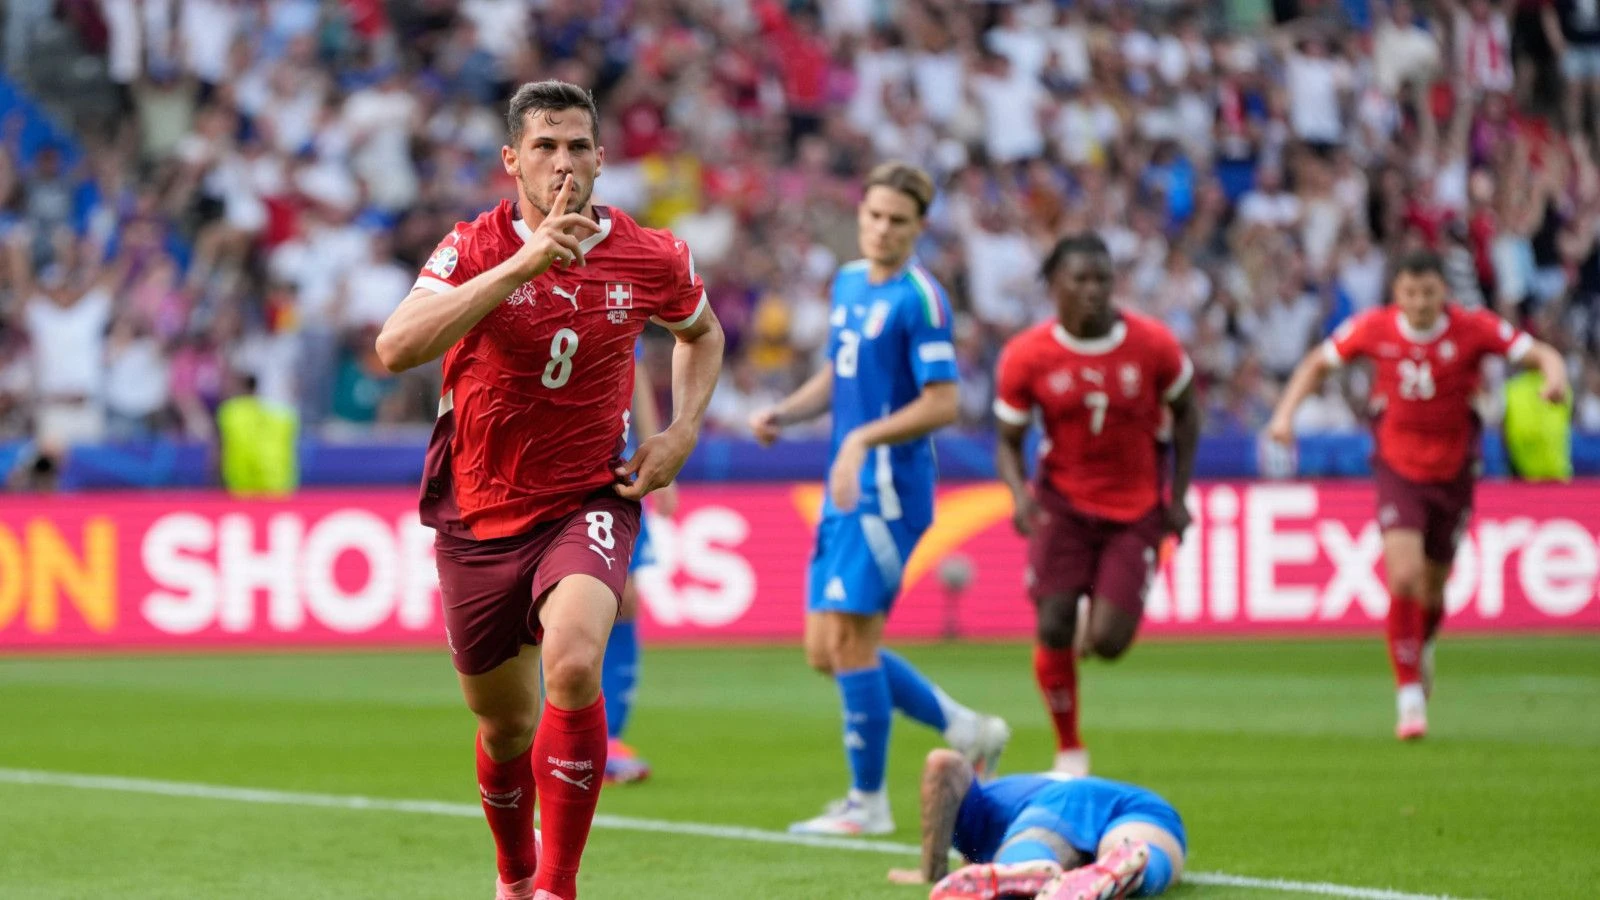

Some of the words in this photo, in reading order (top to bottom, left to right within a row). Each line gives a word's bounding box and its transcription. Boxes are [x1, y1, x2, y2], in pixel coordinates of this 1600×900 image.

[541, 328, 579, 389] 8
[1084, 391, 1109, 435] 7
[585, 511, 615, 550] 8
[0, 516, 118, 634] N
[547, 756, 593, 770] SUISSE
